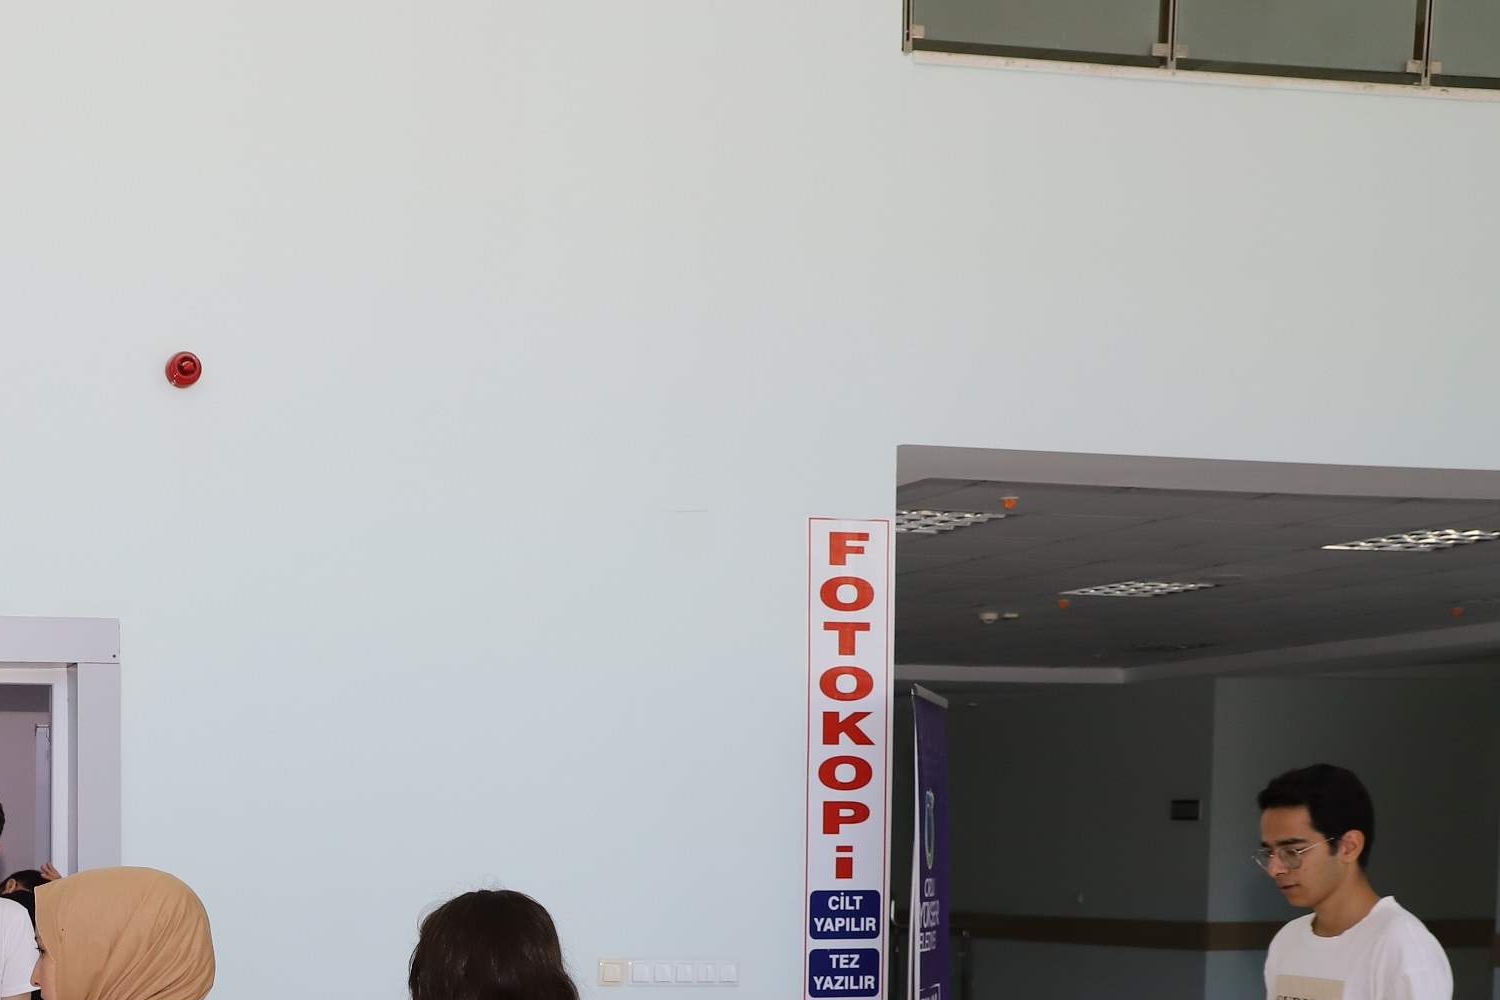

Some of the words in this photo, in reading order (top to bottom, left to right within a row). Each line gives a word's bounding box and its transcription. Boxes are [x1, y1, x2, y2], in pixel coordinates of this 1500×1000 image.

[818, 531, 875, 879] FOTOKOPİ
[827, 892, 863, 911] CİLT
[813, 917, 876, 932] YAPILIR
[829, 954, 860, 968] TEZ
[813, 975, 875, 990] YAZILIR
